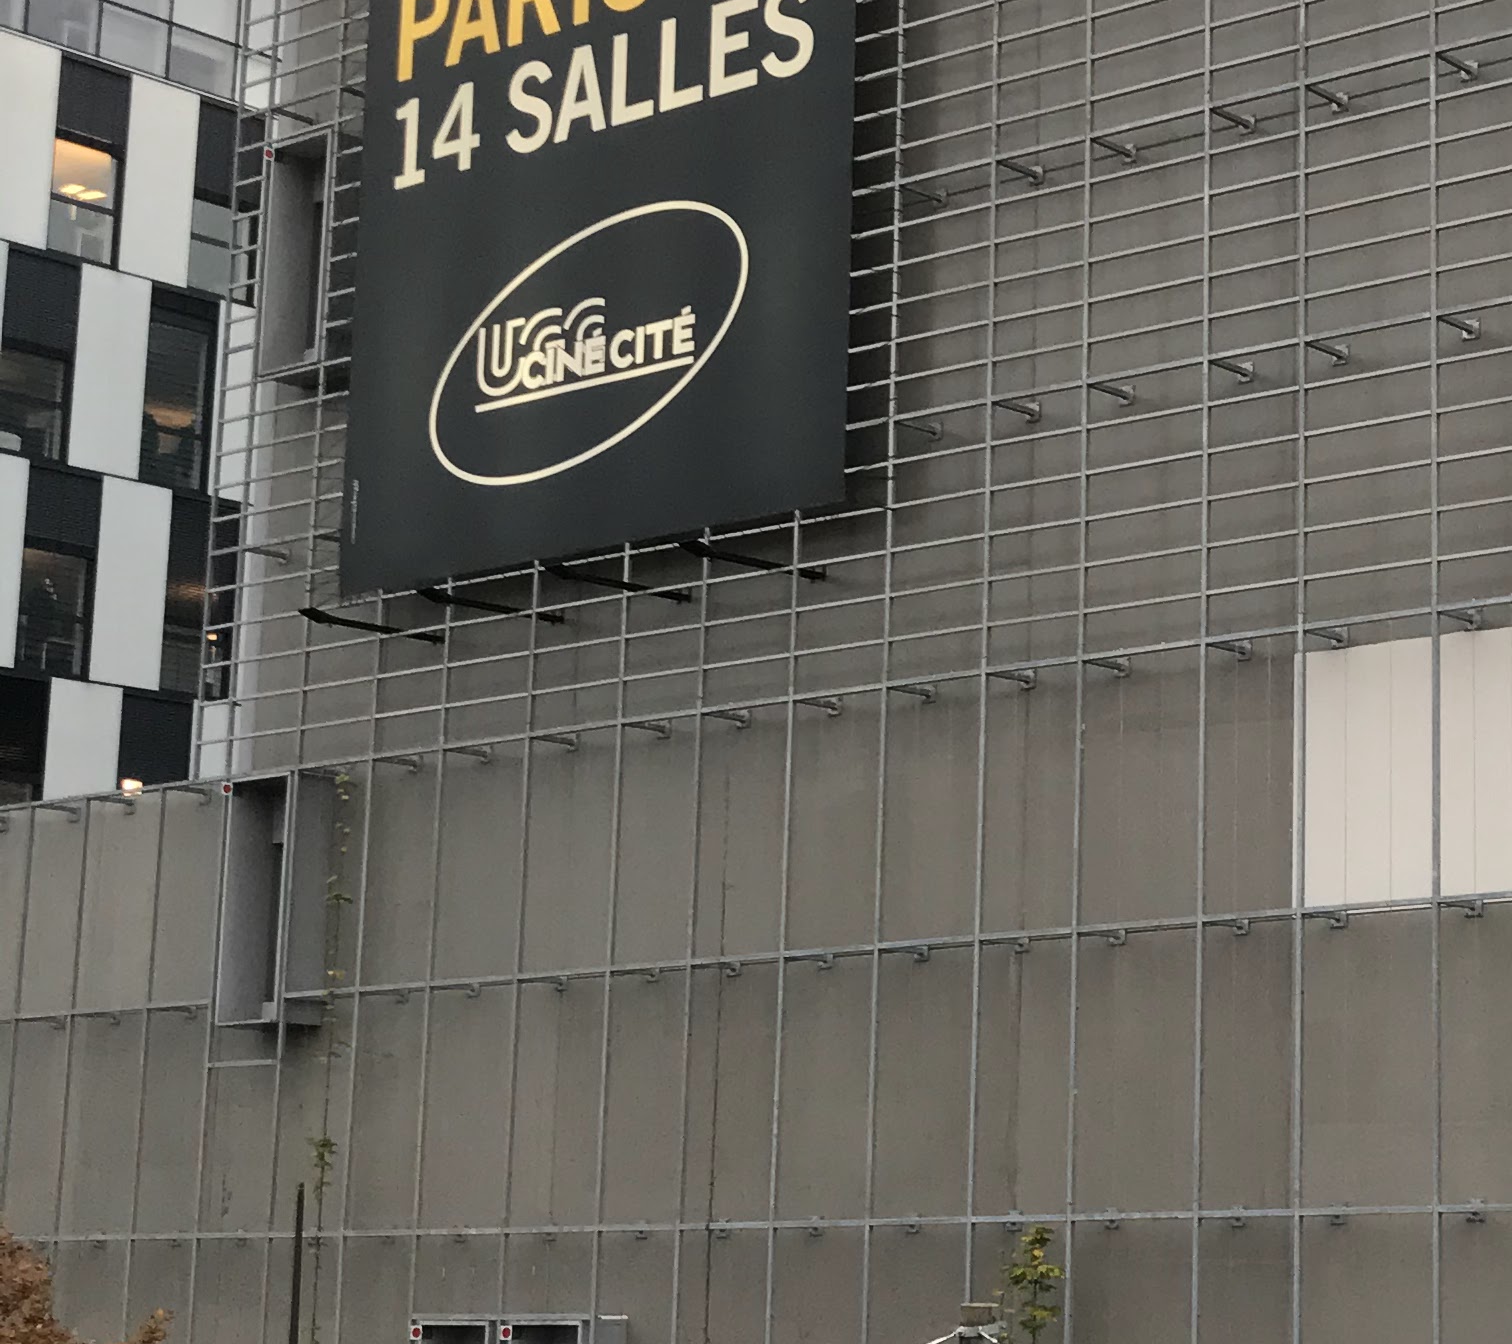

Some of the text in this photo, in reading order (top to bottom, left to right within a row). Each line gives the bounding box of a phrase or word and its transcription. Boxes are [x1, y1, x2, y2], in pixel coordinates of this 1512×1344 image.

[394, 83, 480, 189] 14
[522, 305, 696, 389] CINÉ CITÉ
